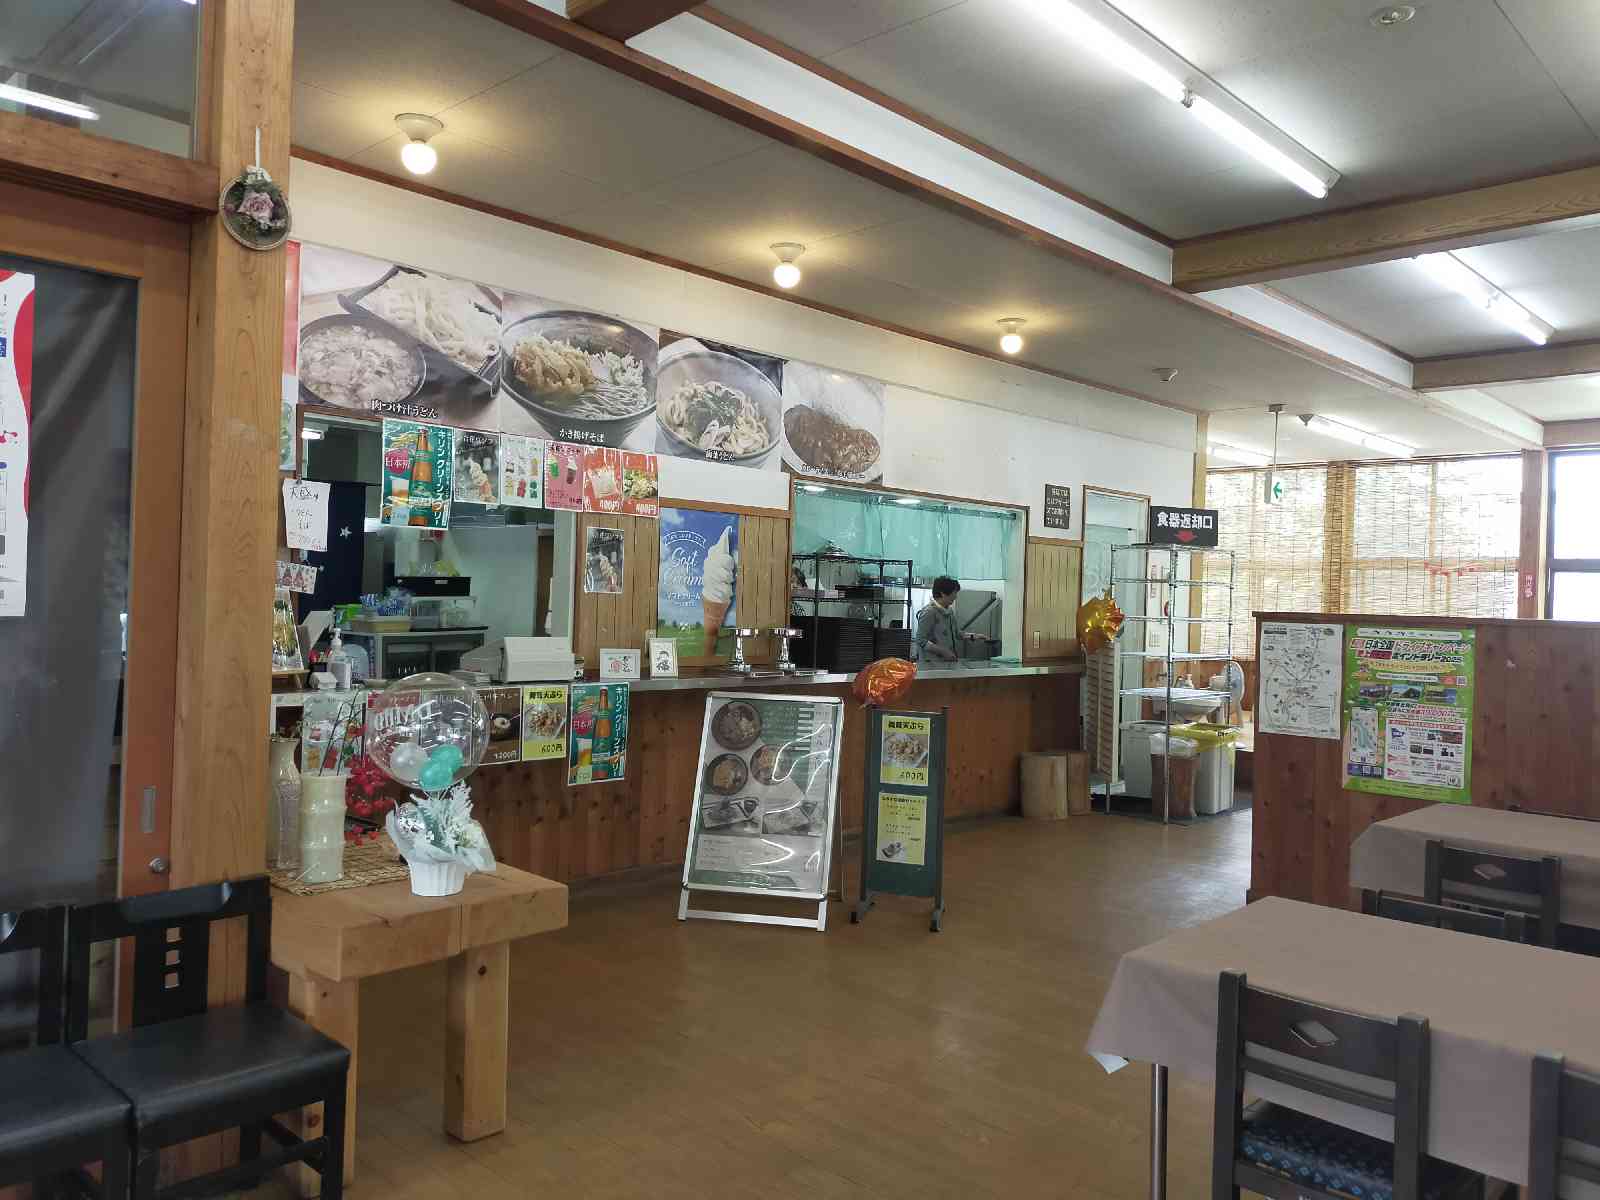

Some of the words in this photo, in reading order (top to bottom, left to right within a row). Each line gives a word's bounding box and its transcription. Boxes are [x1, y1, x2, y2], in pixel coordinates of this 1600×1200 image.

[559, 427, 604, 443] かき揚げそば
[1157, 511, 1213, 530] 食器返却口
[671, 547, 698, 574] Soft
